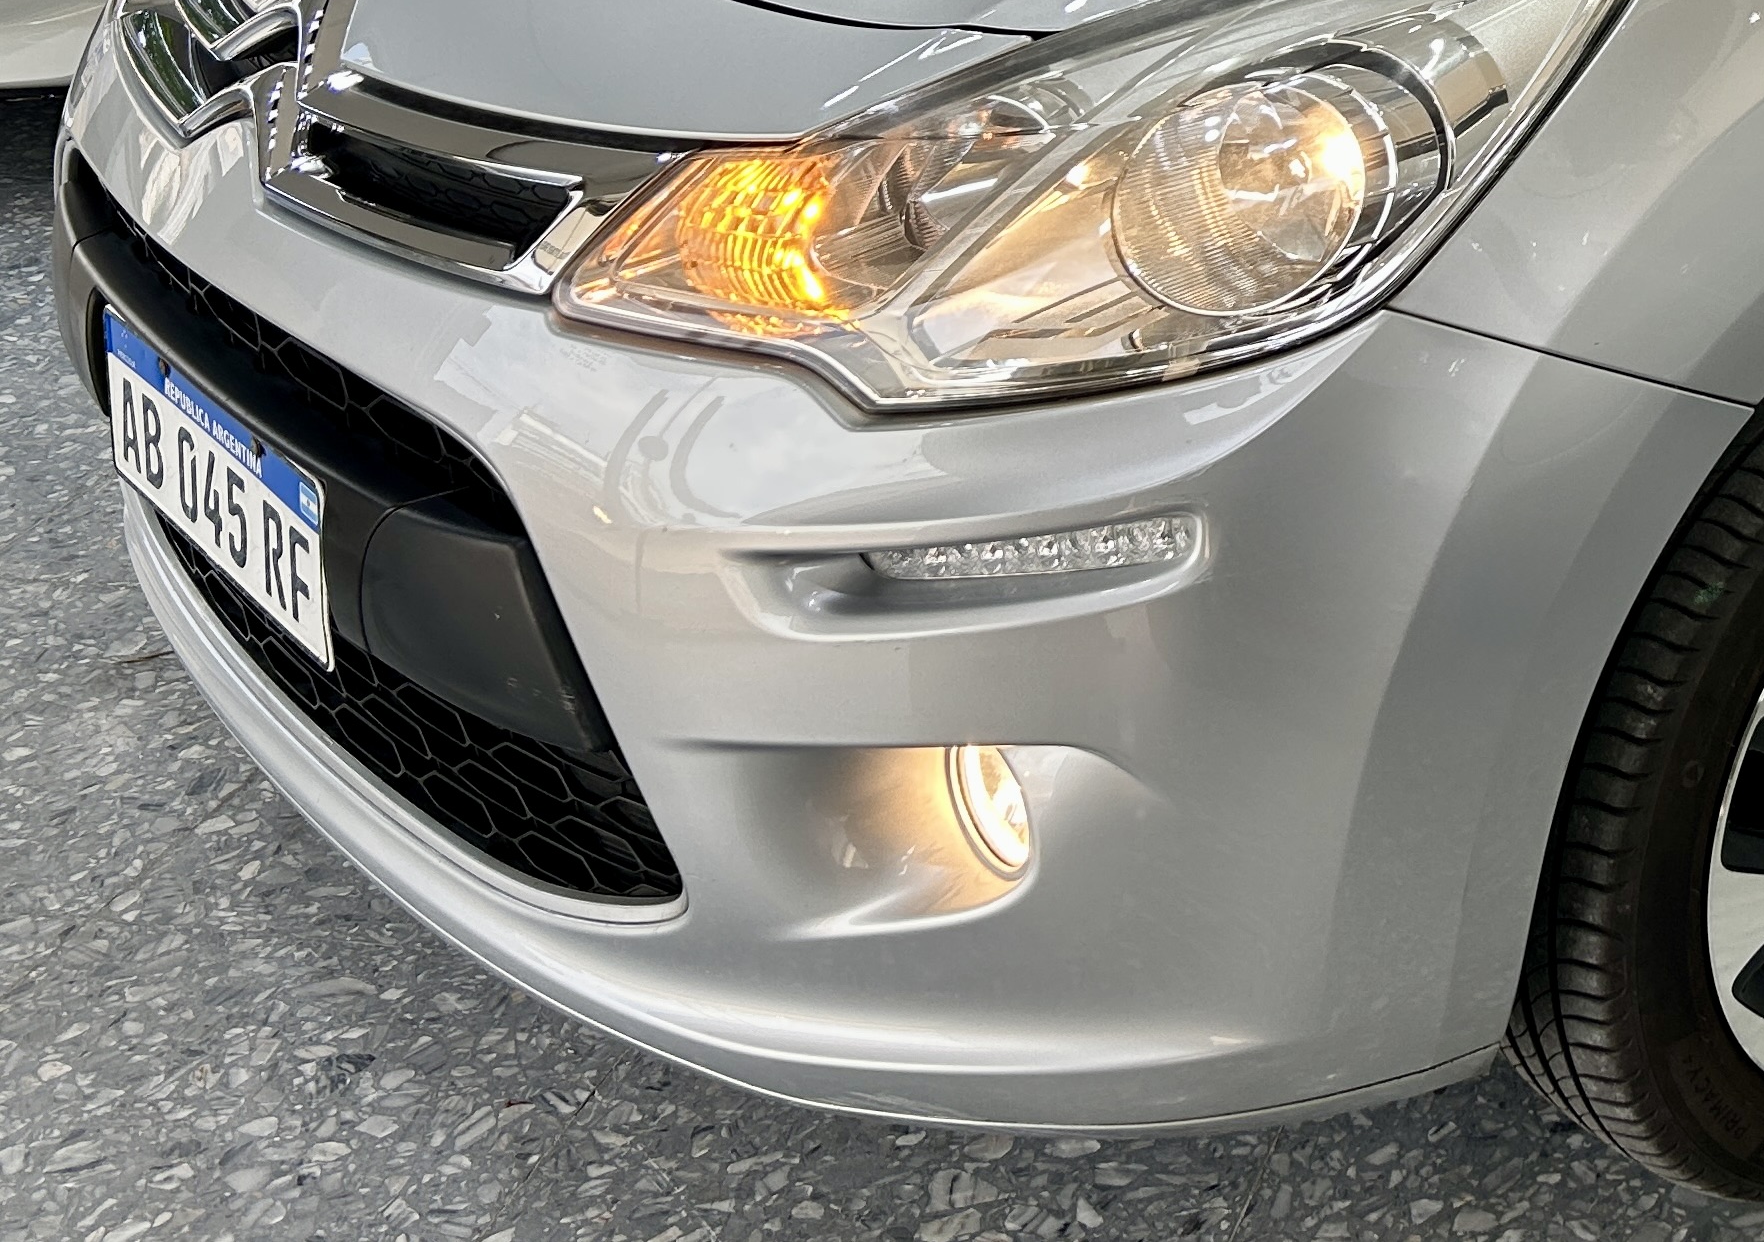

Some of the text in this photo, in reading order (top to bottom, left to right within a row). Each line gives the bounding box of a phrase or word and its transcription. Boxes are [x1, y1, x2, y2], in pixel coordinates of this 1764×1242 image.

[123, 377, 310, 623] AB 045 RF
[164, 377, 263, 478] REPUBLICA ARGENTINA
